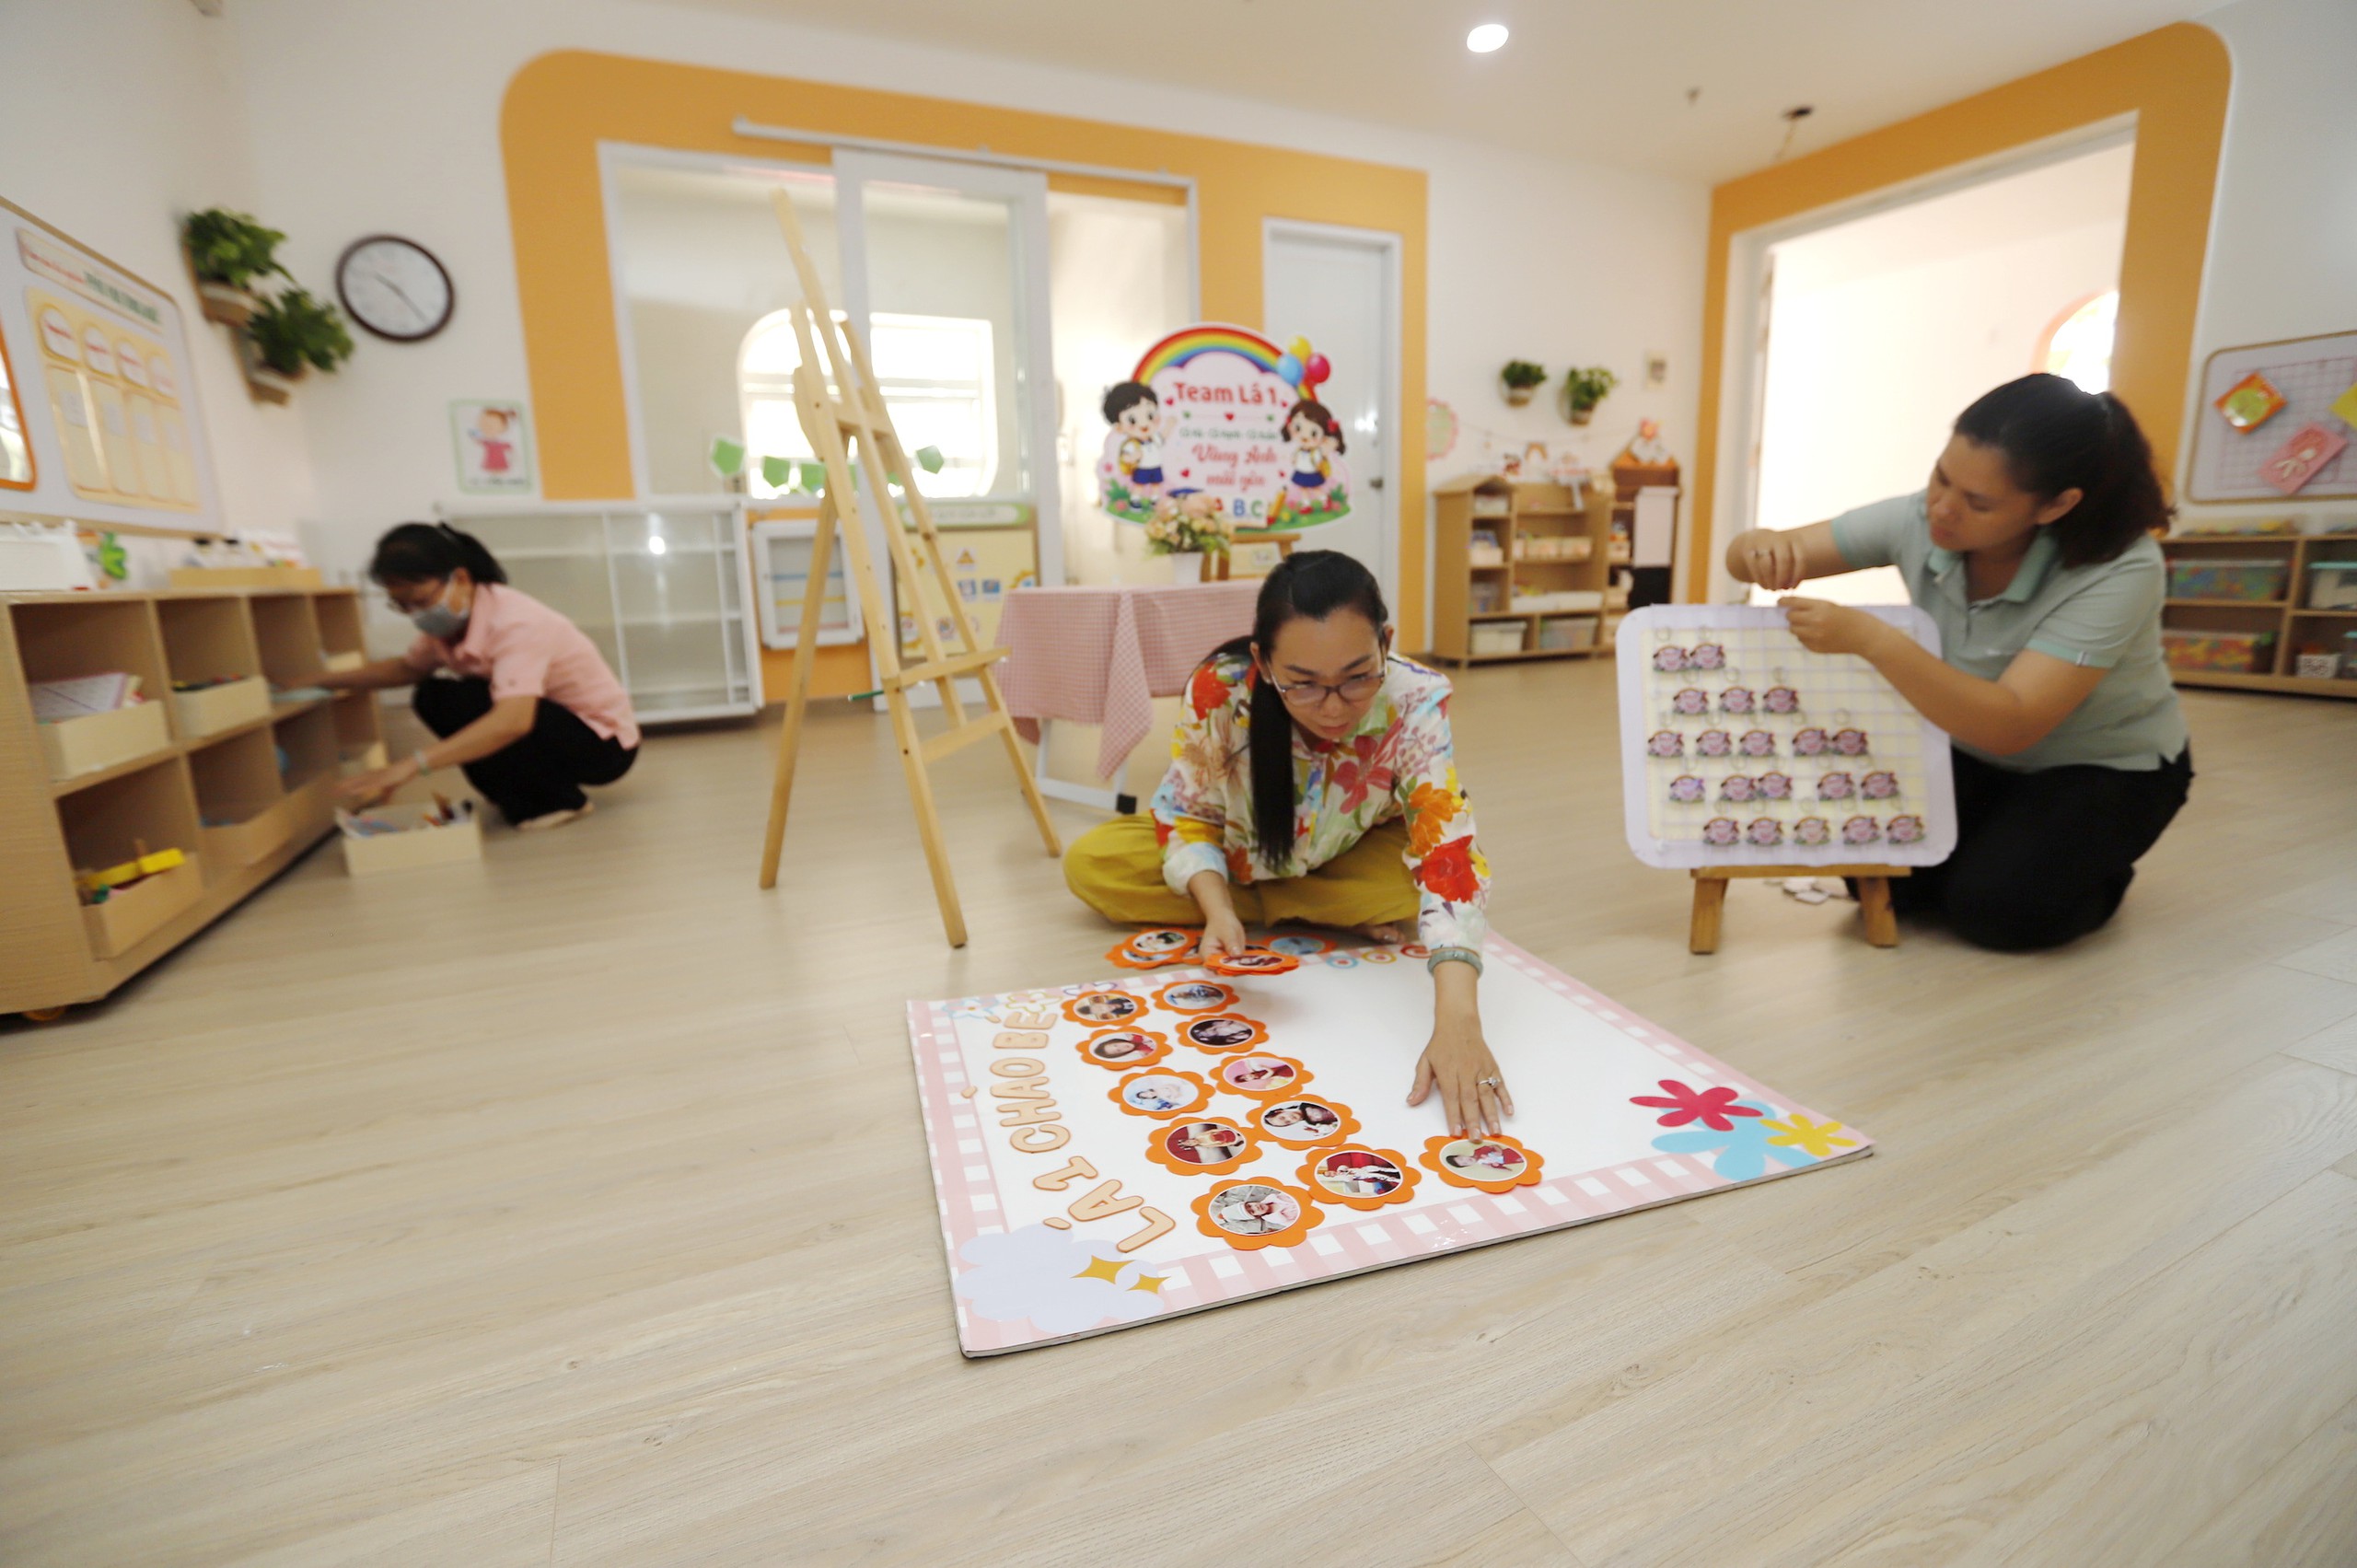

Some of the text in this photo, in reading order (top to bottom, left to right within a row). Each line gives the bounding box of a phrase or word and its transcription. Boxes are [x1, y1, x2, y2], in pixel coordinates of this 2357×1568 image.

[1175, 381, 1277, 404] Team Lá 1
[960, 1011, 1177, 1253] LÁ 1 CHÀO BÉ
